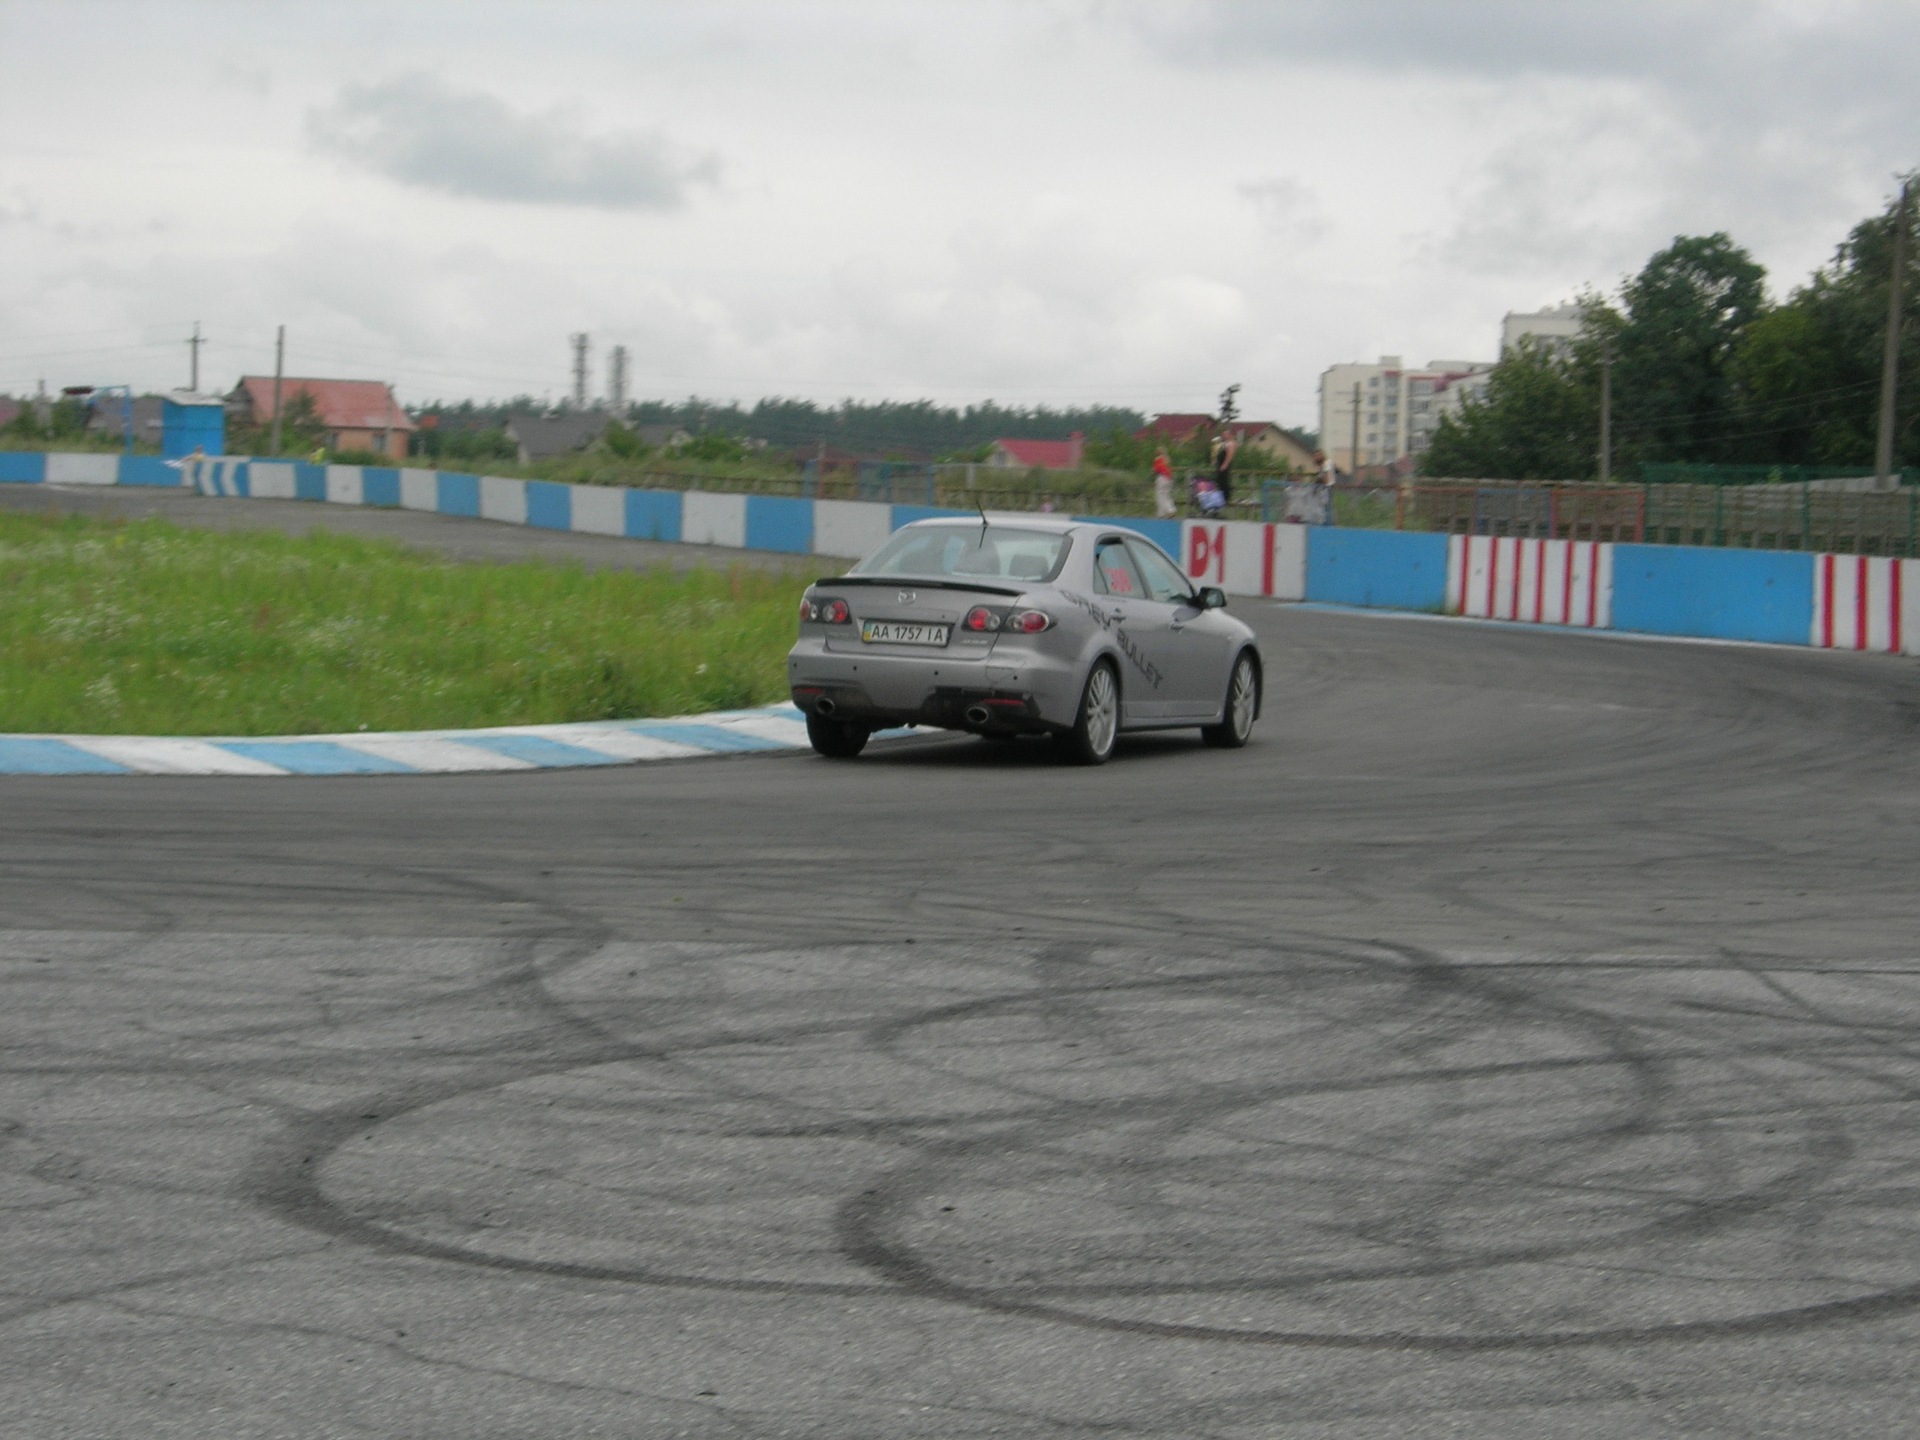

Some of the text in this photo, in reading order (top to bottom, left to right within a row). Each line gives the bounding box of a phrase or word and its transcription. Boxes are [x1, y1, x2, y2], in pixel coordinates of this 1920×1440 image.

[1189, 525, 1226, 583] D1
[871, 625, 889, 639] AA
[895, 626, 923, 640] 1757
[927, 628, 943, 642] IA
[1116, 628, 1163, 690] BULLET
